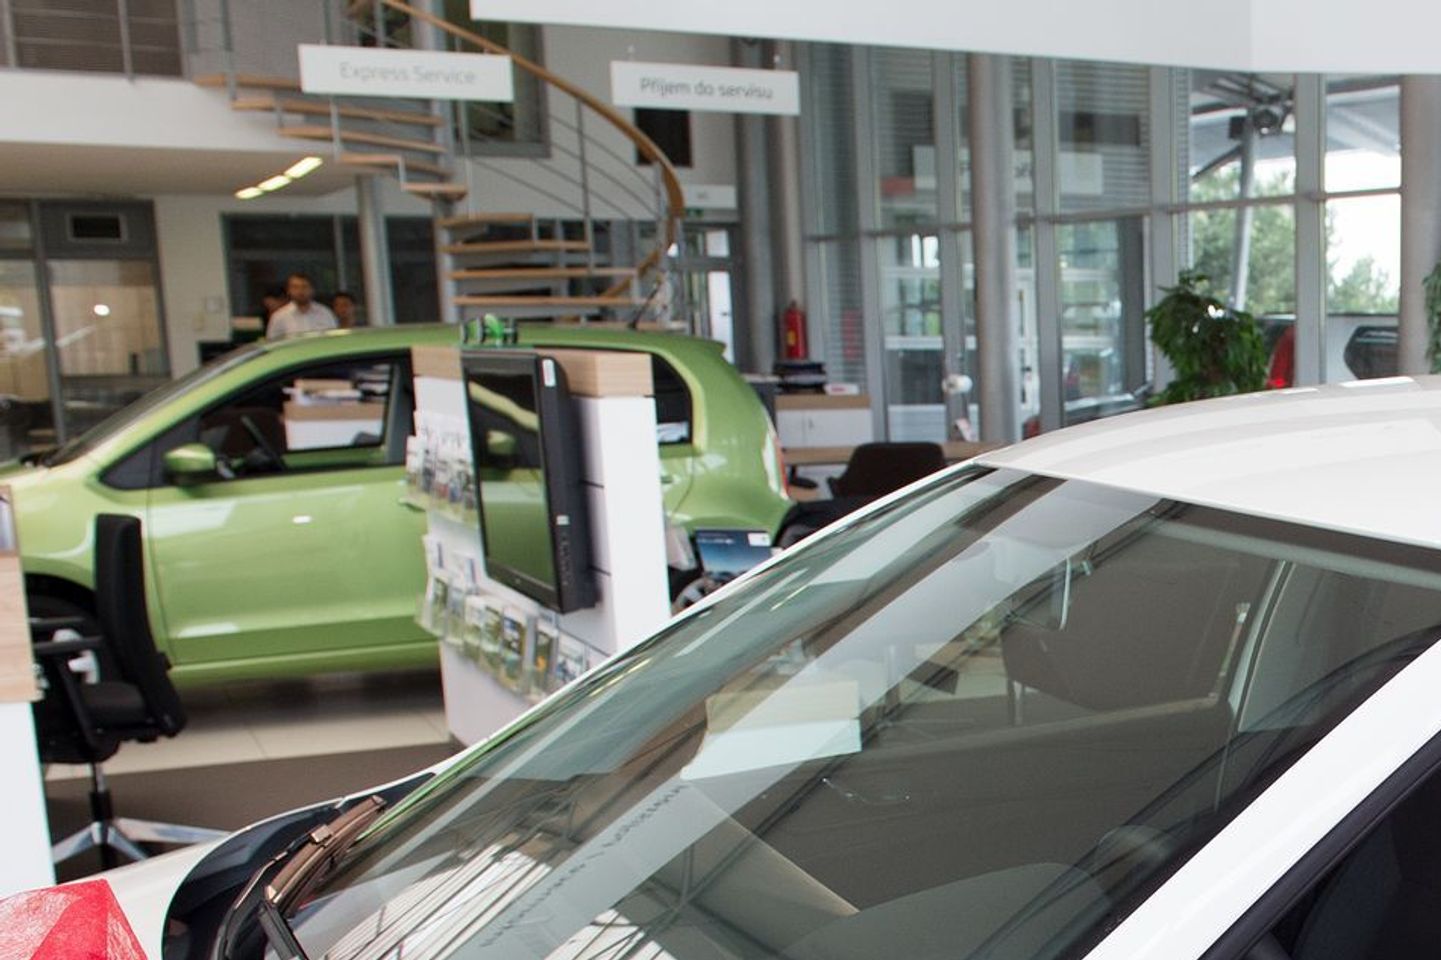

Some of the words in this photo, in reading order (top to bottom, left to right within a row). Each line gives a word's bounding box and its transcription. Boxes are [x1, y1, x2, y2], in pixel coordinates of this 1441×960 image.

[339, 61, 409, 82] Express
[413, 65, 476, 85] Service
[694, 81, 715, 97] do
[718, 82, 773, 99] servisu
